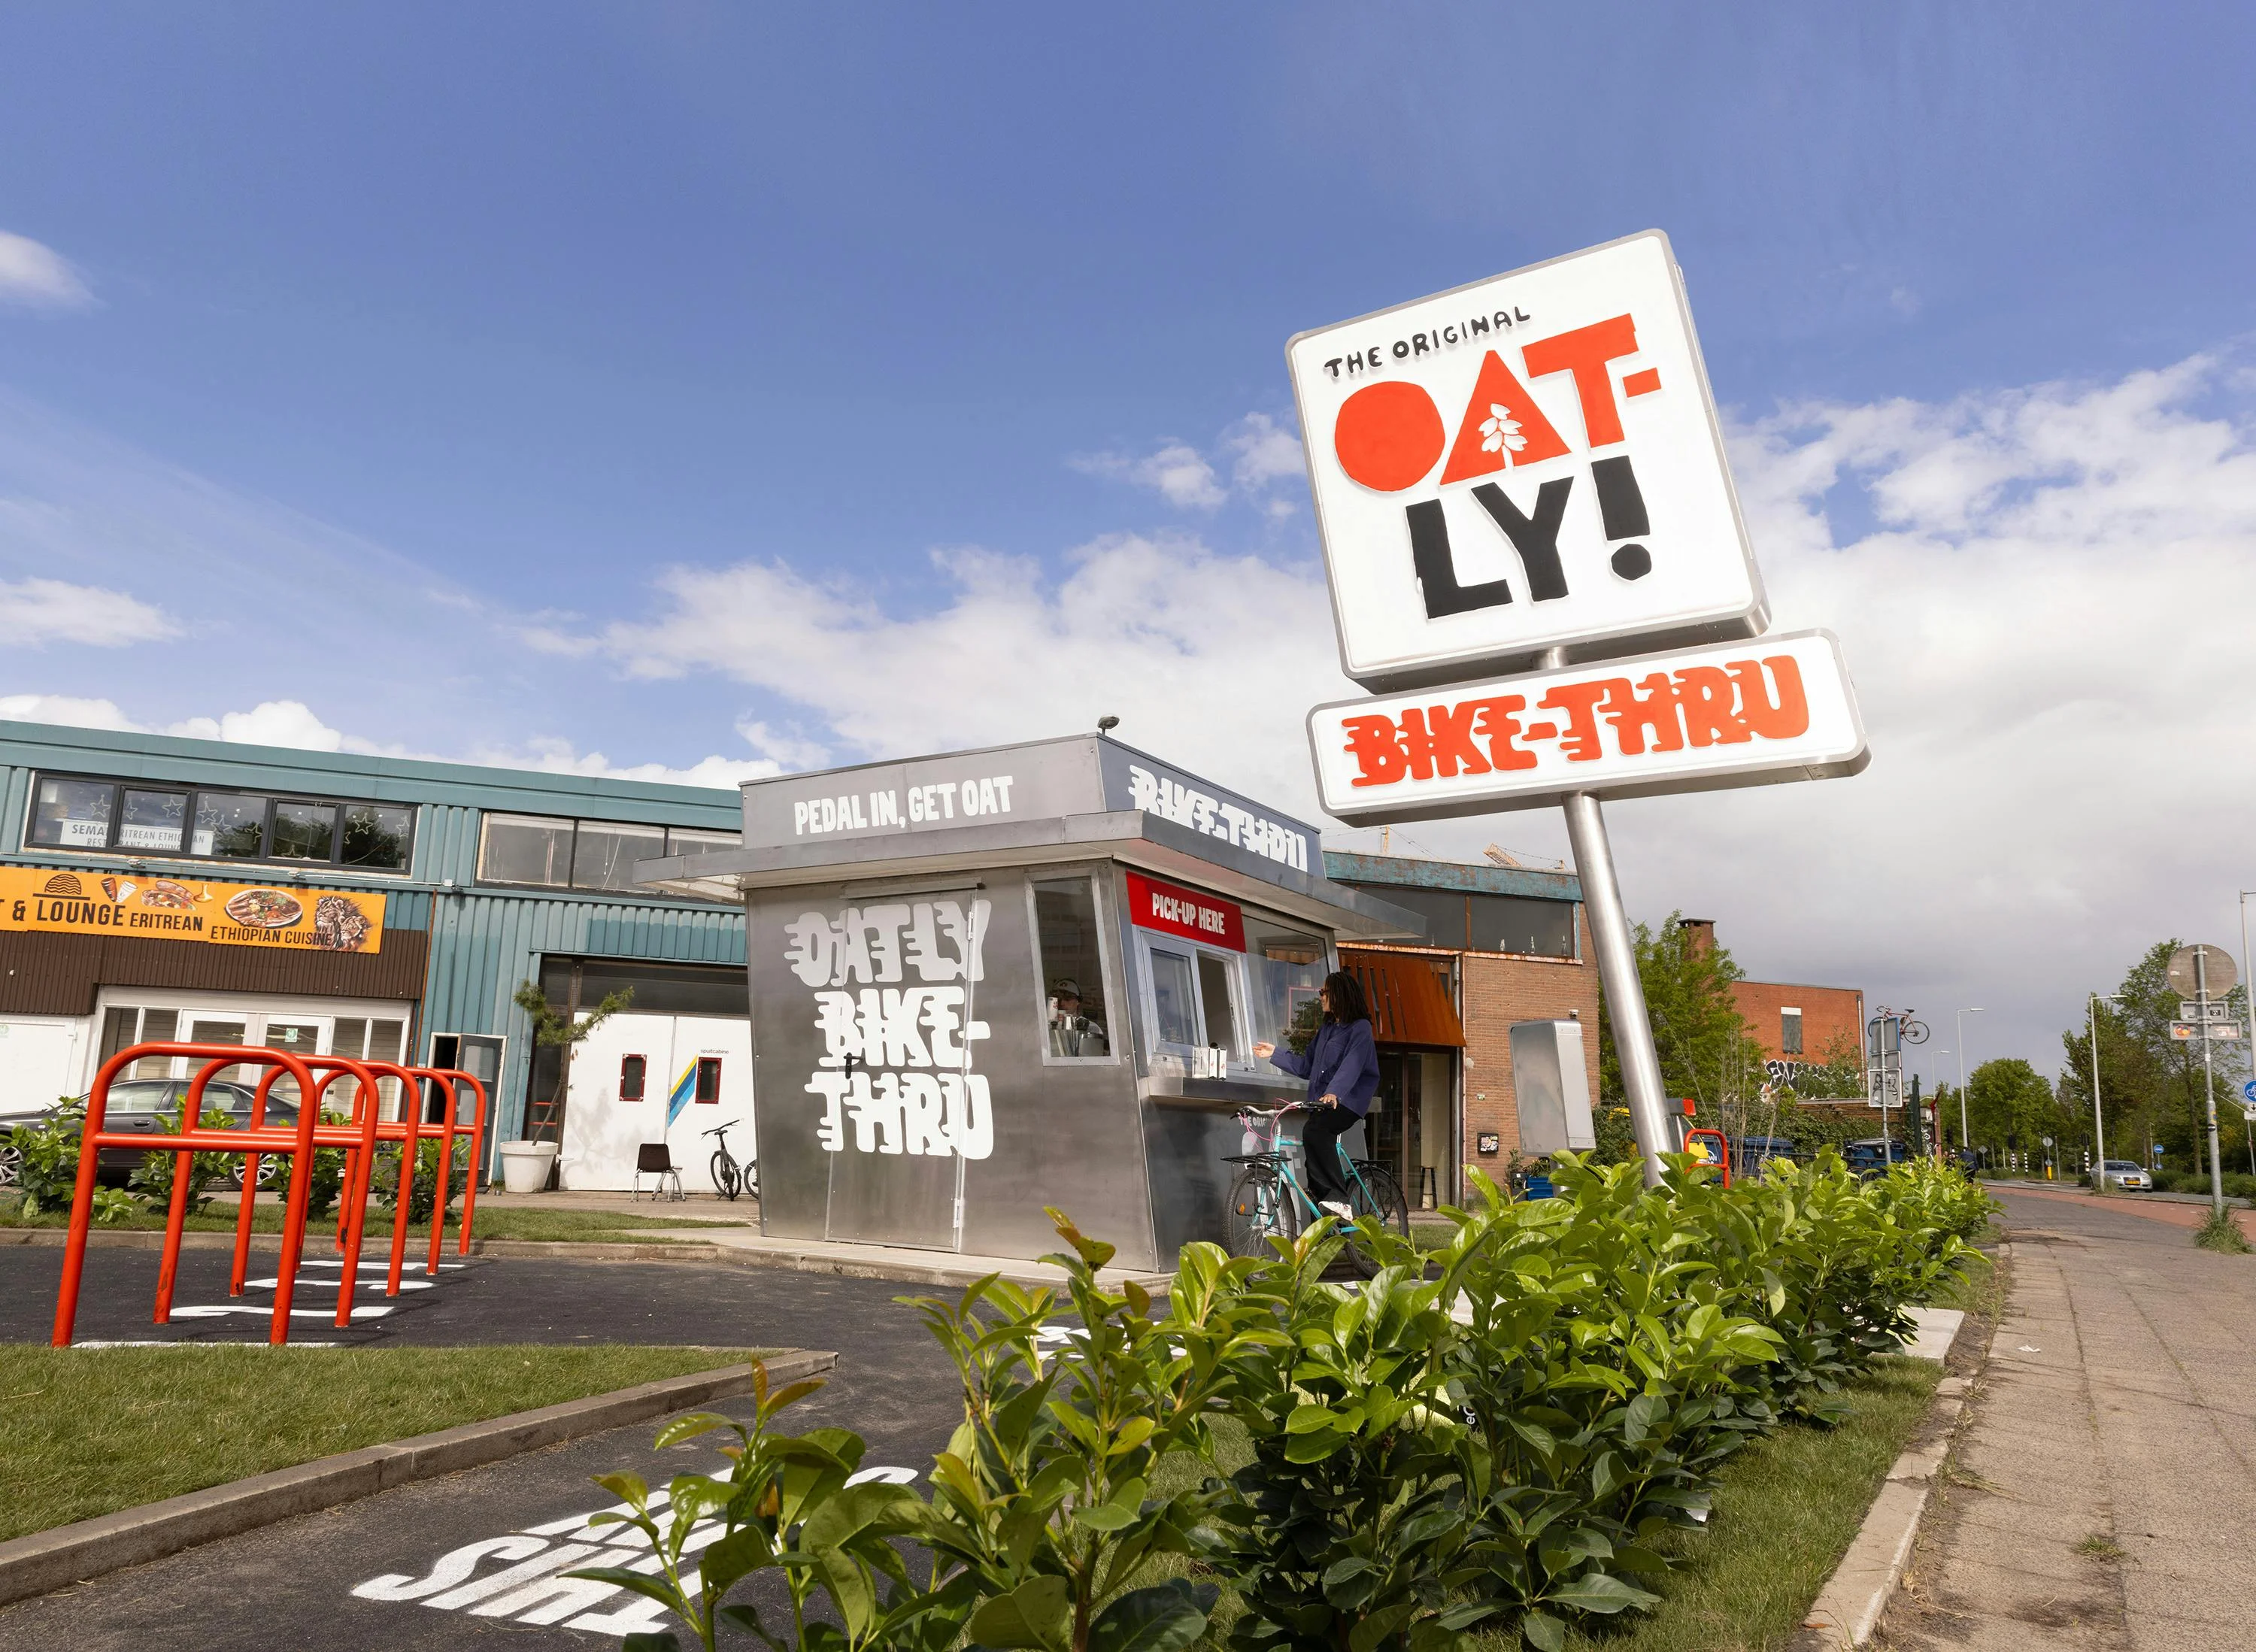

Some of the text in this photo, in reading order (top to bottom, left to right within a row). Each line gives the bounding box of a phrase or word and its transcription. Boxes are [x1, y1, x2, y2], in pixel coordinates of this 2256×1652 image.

[1324, 305, 1532, 379] THE ORIGINAL
[1334, 312, 1662, 492] OAT-
[1405, 454, 1652, 620] LY!
[1341, 653, 1810, 789] BIKE-THRU
[120, 829, 155, 841] RITREAN
[794, 775, 1014, 835] PEDAL IN, GET OAT
[12, 900, 26, 922] &
[37, 899, 126, 926] LOUNGE
[129, 912, 203, 932] ERITREAN
[211, 926, 280, 943] ETHIOPIAN
[285, 931, 332, 947] CUISINE
[784, 900, 992, 987] OATLY
[1151, 893, 1225, 935] PICK-UP HERE
[814, 986, 990, 1069] BIKE-
[804, 1072, 994, 1160] THRU
